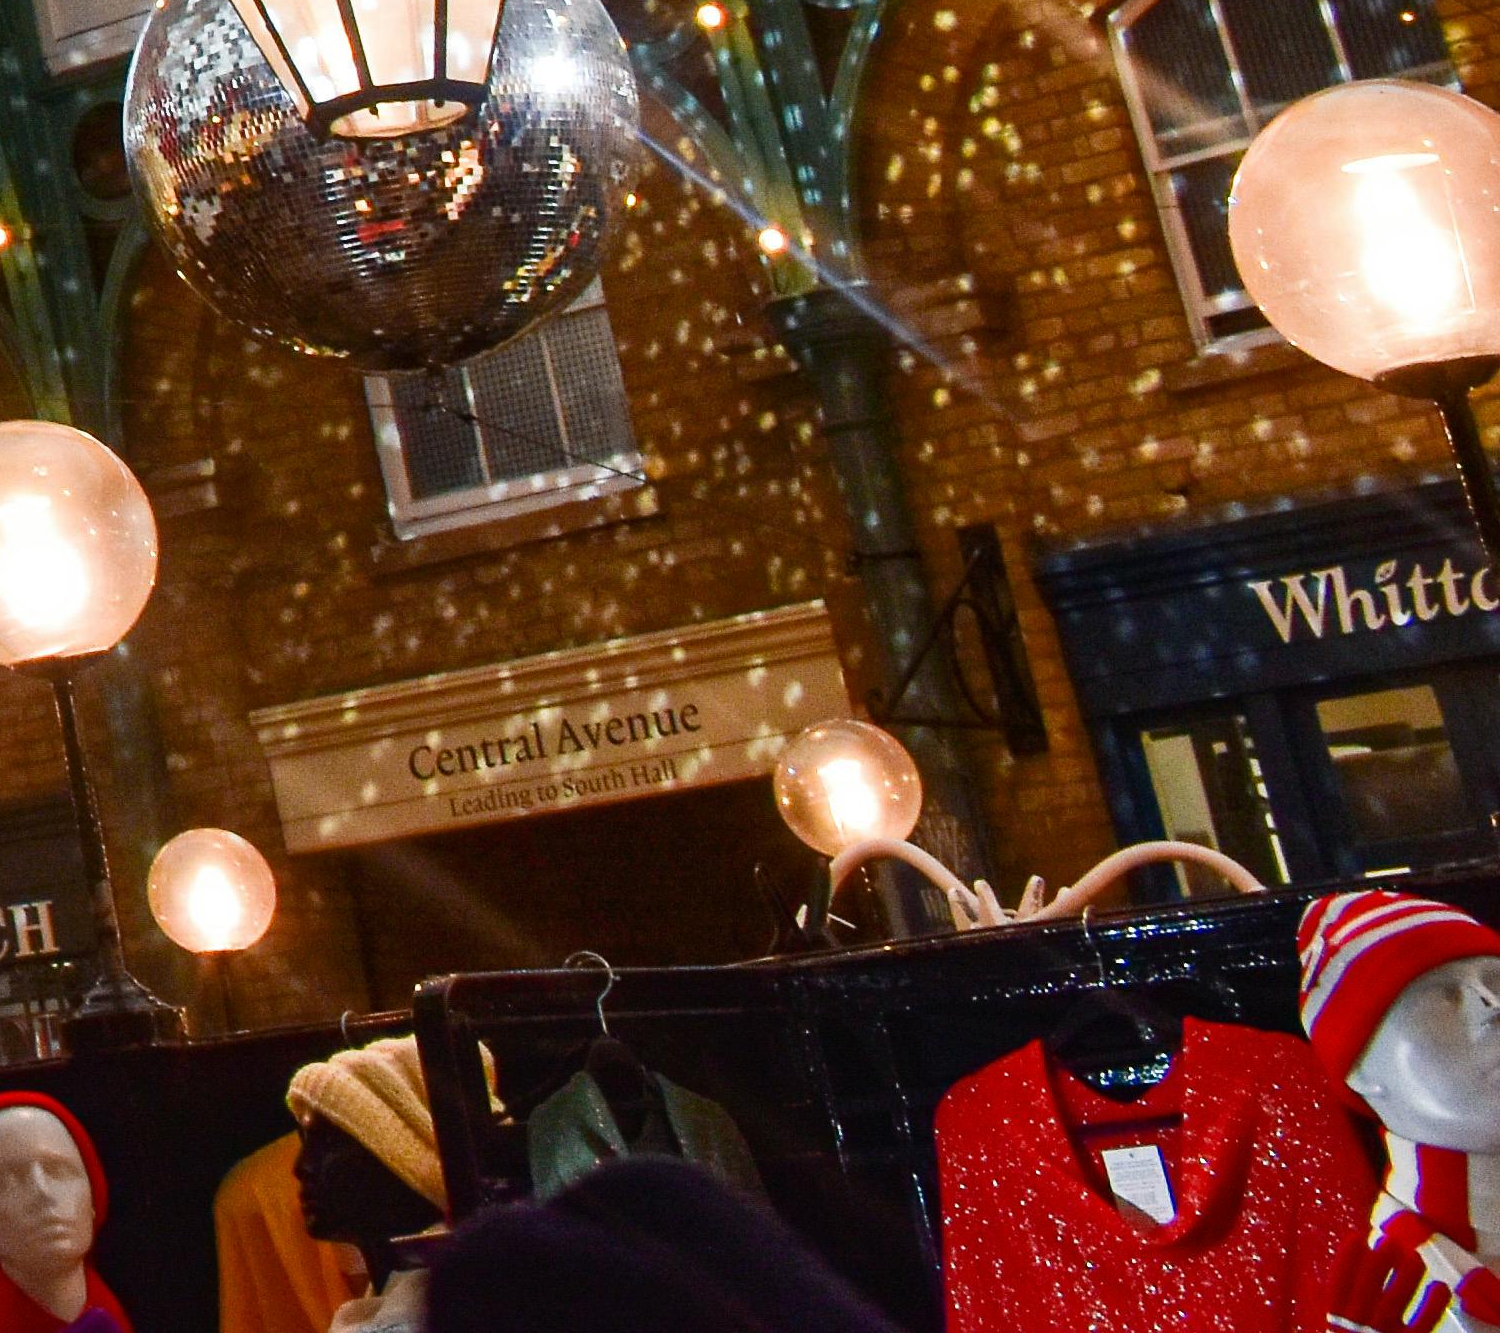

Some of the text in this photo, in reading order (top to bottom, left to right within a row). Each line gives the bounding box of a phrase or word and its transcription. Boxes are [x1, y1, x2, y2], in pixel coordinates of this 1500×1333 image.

[408, 701, 702, 780] Central Avenue
[448, 759, 678, 818] Leading to South Hall
